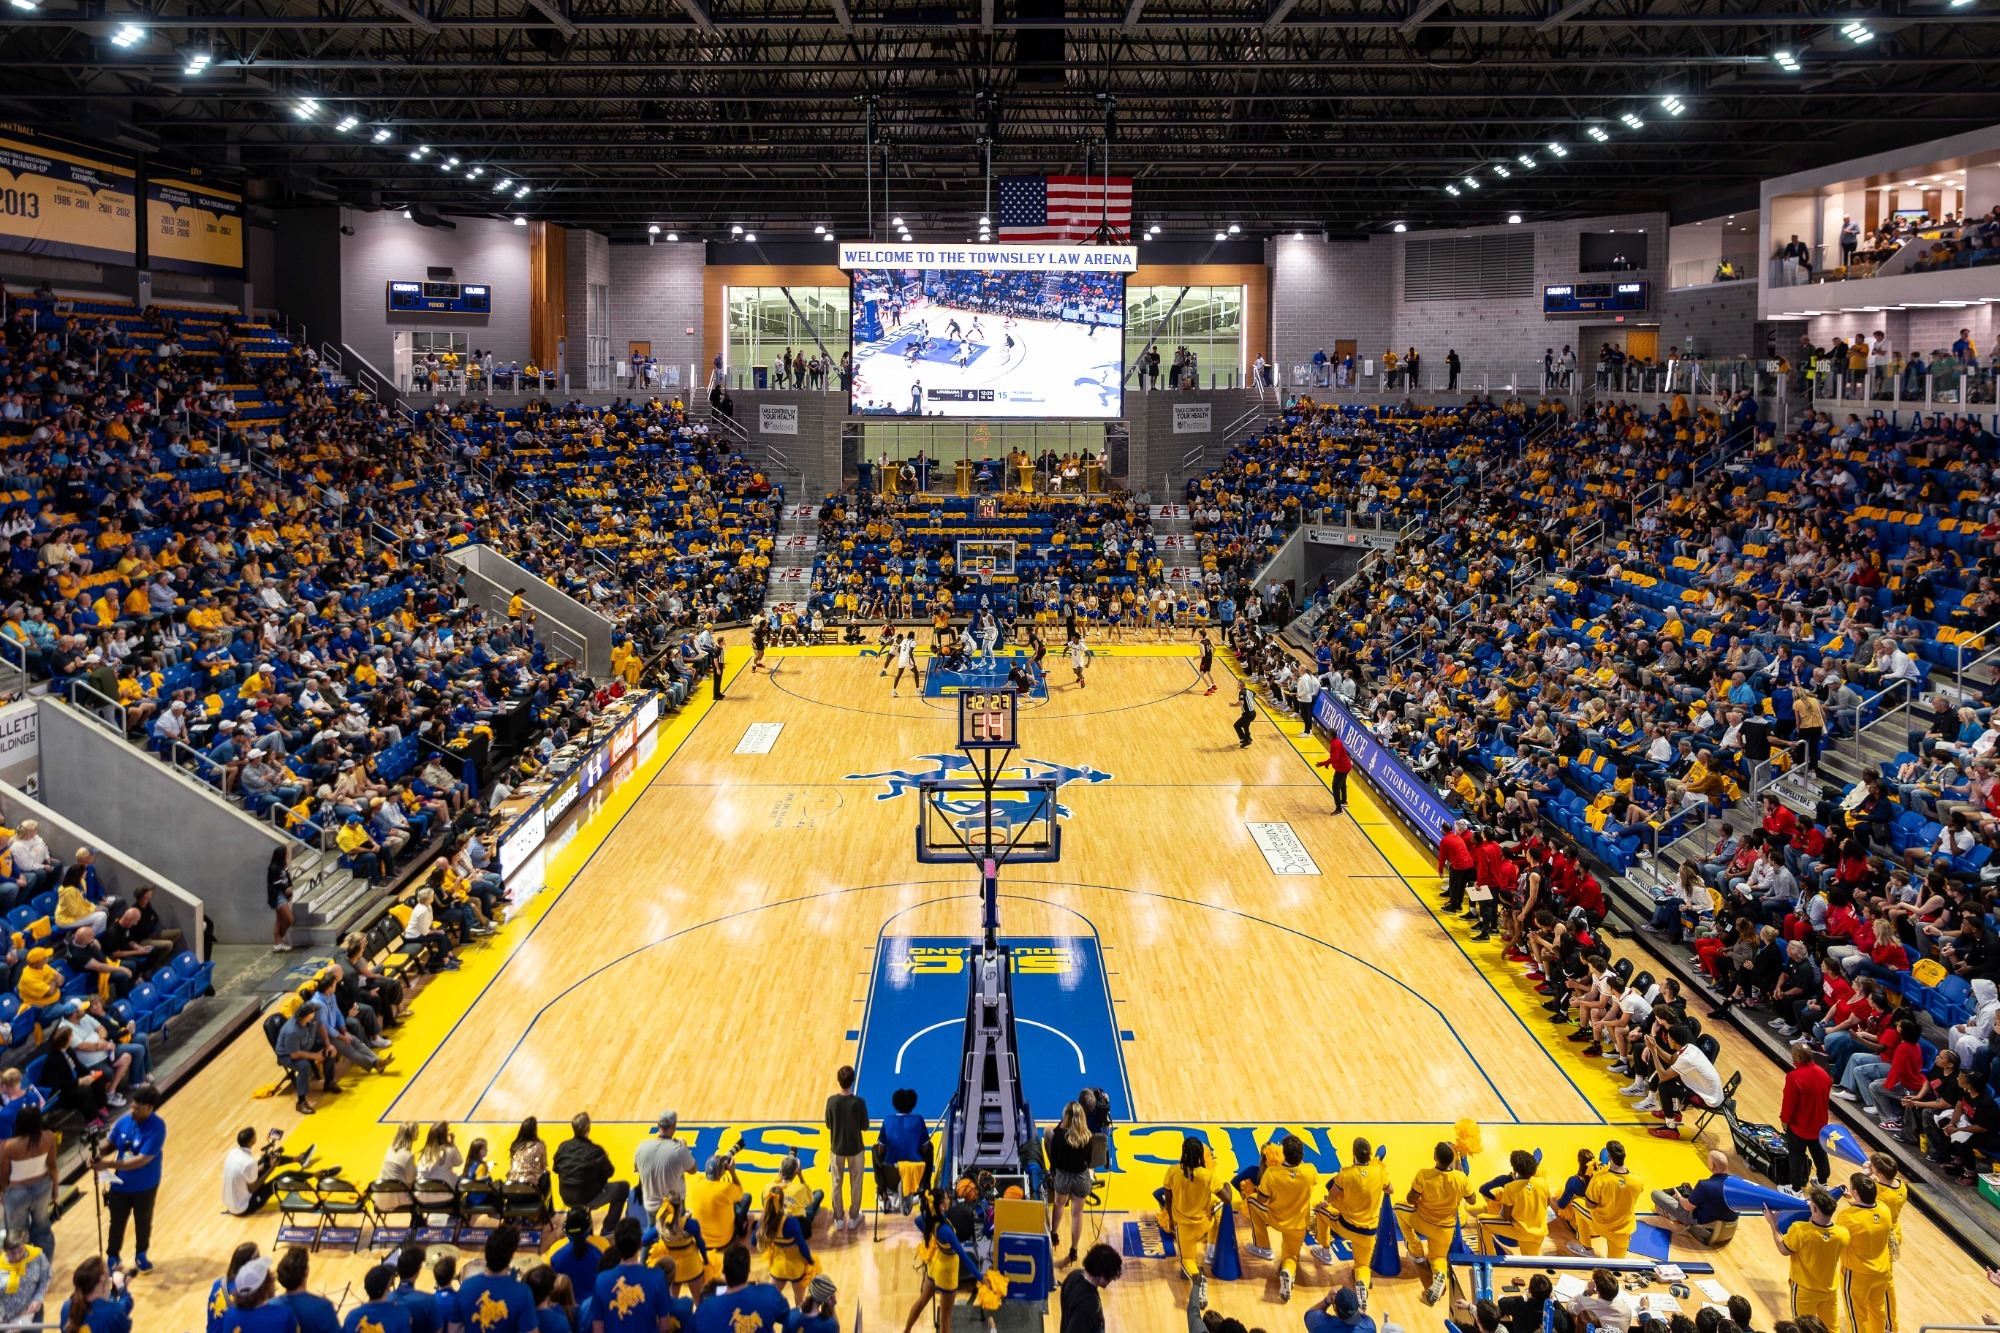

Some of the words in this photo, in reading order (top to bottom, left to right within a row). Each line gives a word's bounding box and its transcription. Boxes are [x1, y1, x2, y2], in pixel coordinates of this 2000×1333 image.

[75, 198, 90, 209] 2011
[116, 206, 131, 217] 2012
[845, 251, 914, 263] WELCOME
[917, 251, 935, 263] TO
[938, 251, 966, 263] THE
[968, 252, 1046, 265] TOWNSLEY
[1049, 252, 1081, 265] LAW
[1084, 253, 1133, 266] ARENA
[1294, 365, 1306, 374] GA
[1766, 360, 1780, 373] 105
[1815, 360, 1831, 373] 106
[967, 391, 975, 399] 6
[997, 391, 1008, 399] 15
[984, 506, 994, 517] 14
[1316, 530, 1344, 539] Sanctuary
[902, 643, 907, 652] 3
[968, 694, 1010, 710] 12:27
[982, 712, 1004, 738] 14
[1319, 699, 1348, 738] VERON
[1344, 725, 1369, 759] BICE
[1381, 764, 1420, 806] ATTORNEYS
[1418, 800, 1432, 817] AT
[1137, 1222, 1166, 1257] COWBOYS
